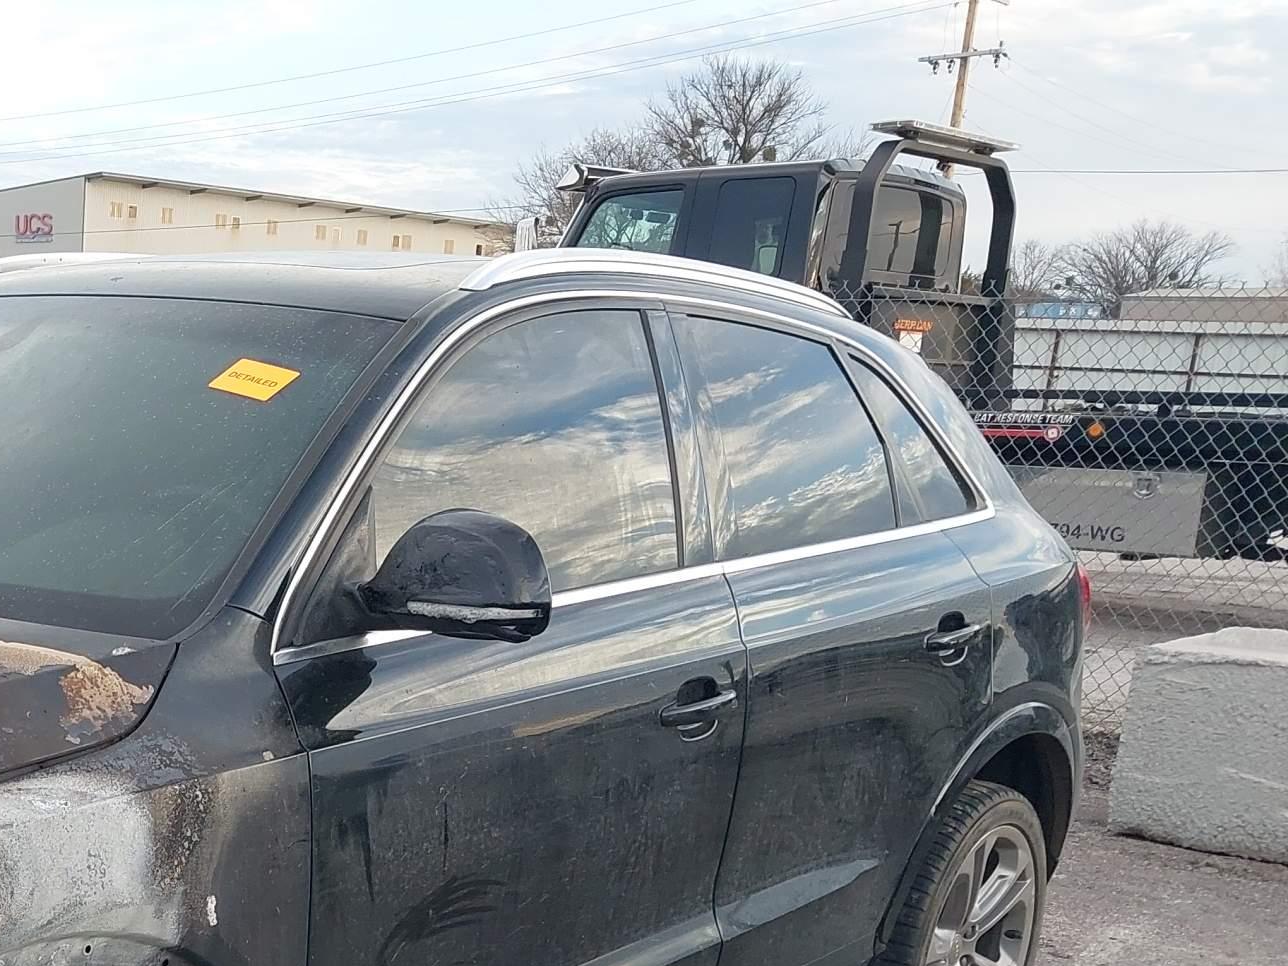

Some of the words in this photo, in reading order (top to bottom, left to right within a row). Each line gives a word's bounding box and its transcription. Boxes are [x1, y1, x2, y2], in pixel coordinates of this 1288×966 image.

[14, 213, 54, 236] UCS
[228, 371, 278, 388] DETAILED
[1045, 414, 1074, 424] TEAM
